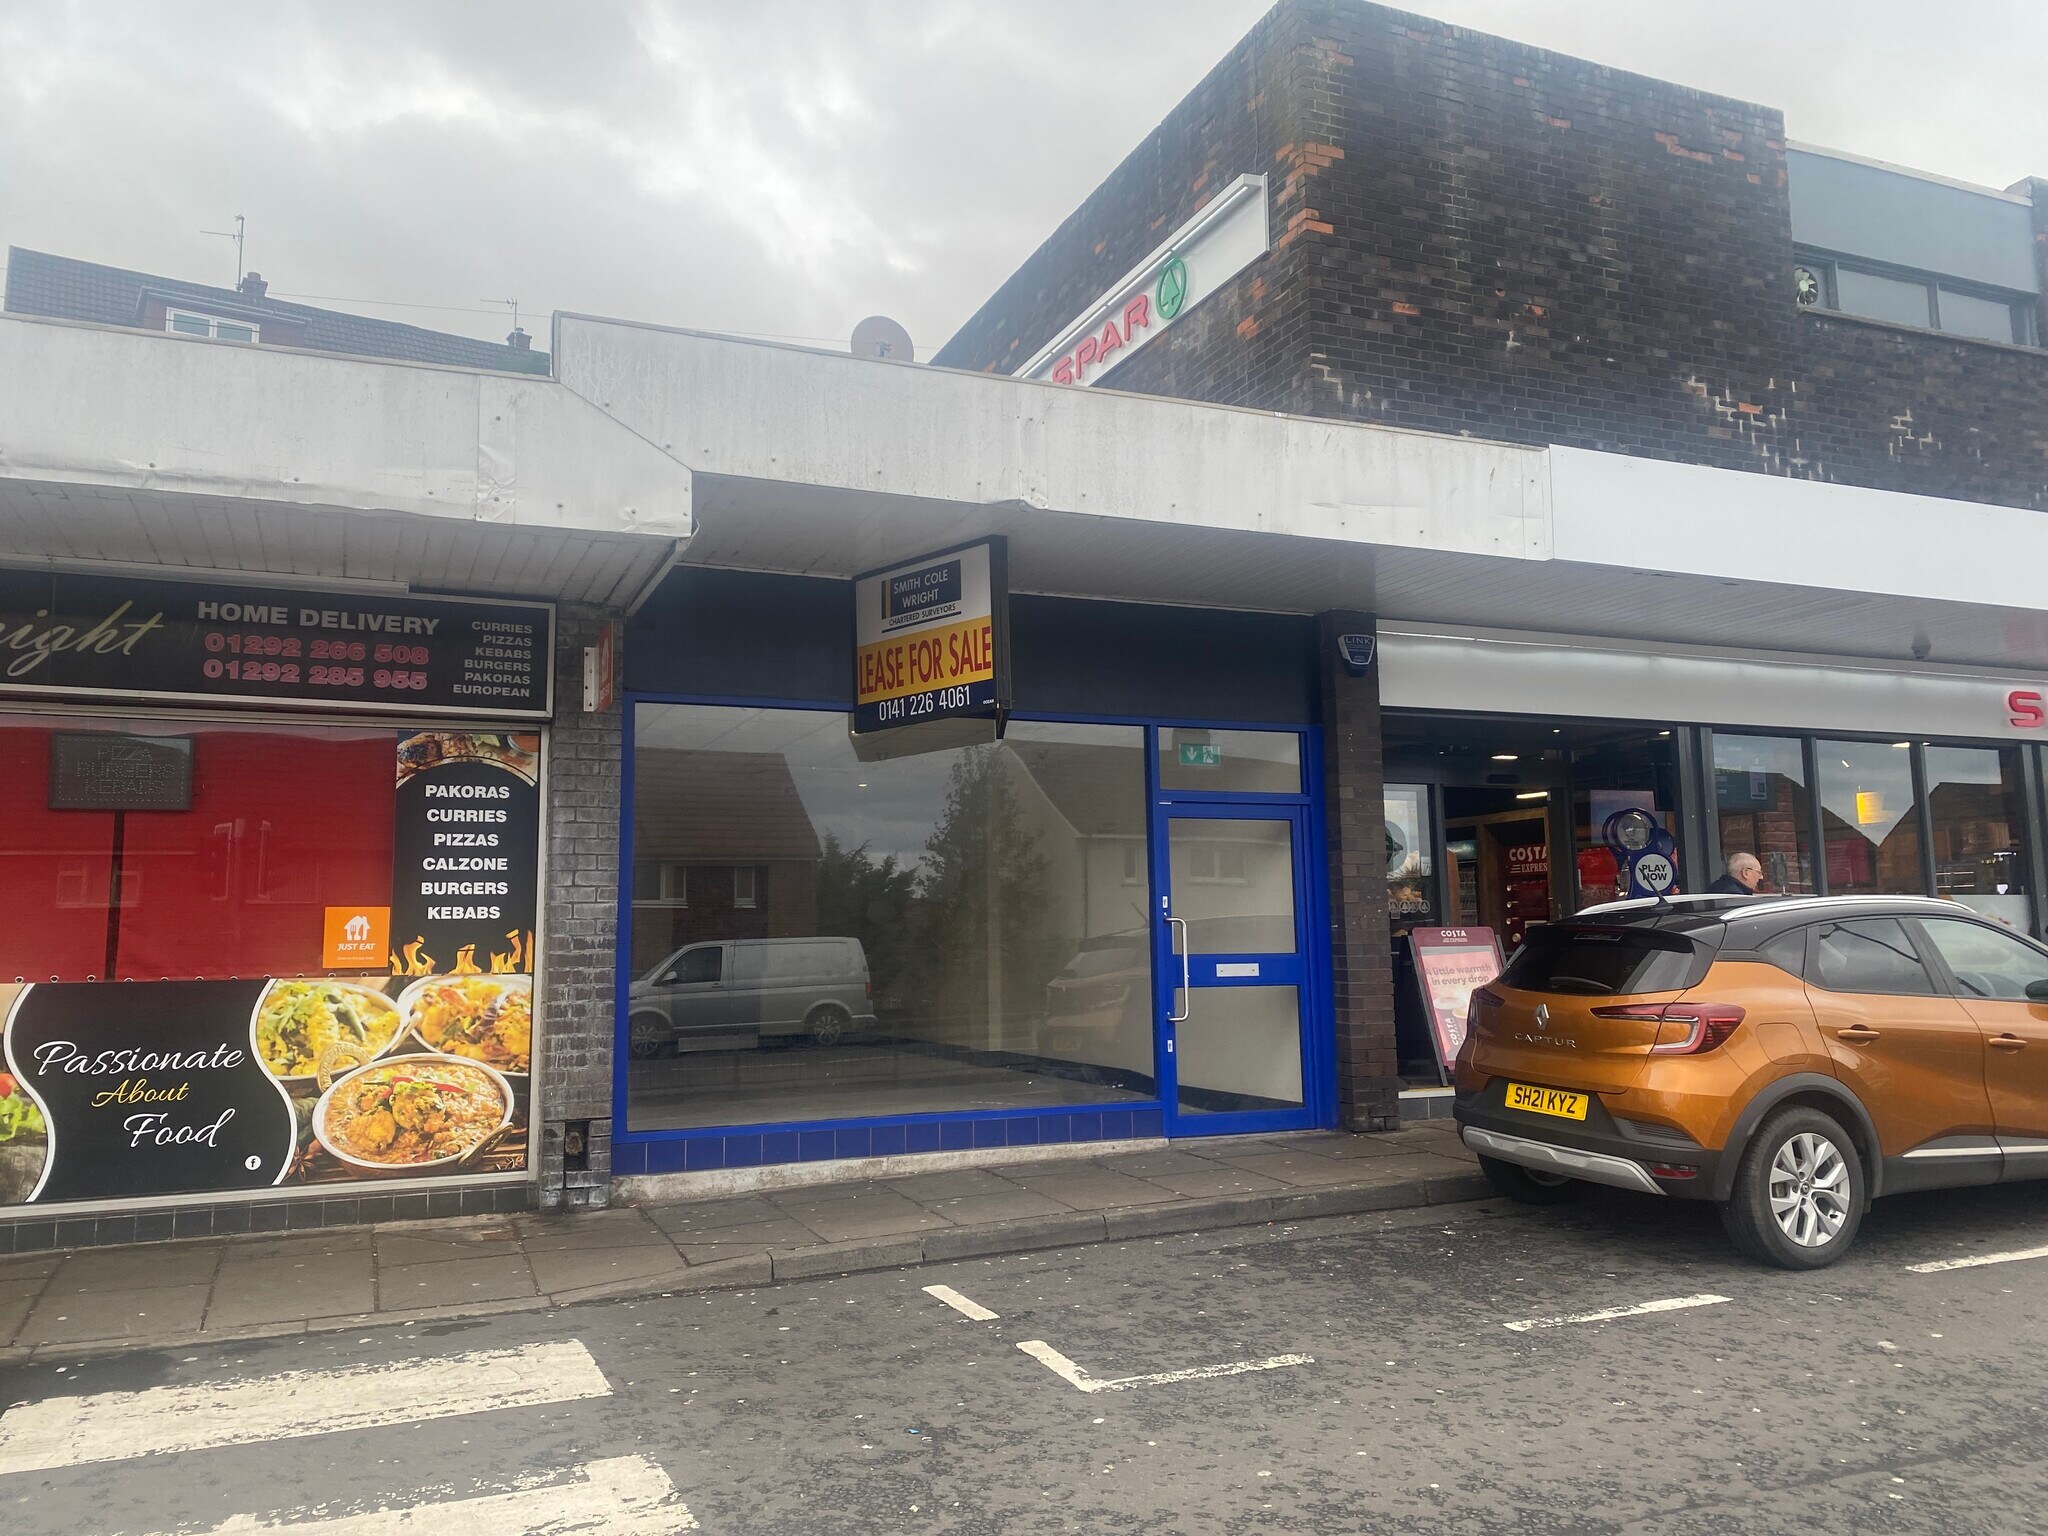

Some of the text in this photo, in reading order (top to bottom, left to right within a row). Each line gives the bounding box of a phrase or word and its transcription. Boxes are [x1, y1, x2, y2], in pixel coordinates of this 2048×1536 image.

[1053, 294, 1149, 385] SPAR
[894, 569, 949, 595] SMITH COLE
[902, 588, 940, 608] WRIGHT
[197, 601, 440, 635] HOME DELIVERY
[889, 603, 956, 627] CHARTERED SURVEYORS
[471, 621, 533, 634] CURRIES
[0, 600, 164, 677] ight
[483, 634, 533, 647] PIZZAS
[1345, 637, 1371, 645] LINK
[205, 632, 429, 665] 01292 266 508
[475, 647, 532, 660] KEBABS
[464, 659, 532, 672] BURGERS
[859, 625, 992, 695] LEASE FOR SALE
[203, 658, 428, 691] 01292 285 955
[464, 672, 531, 685] PAKORAS
[453, 684, 530, 698] EUROPEAN
[878, 685, 971, 721] 0141 226 4061
[2008, 691, 2044, 727] S
[425, 785, 510, 799] PAKORAS
[426, 809, 507, 823] CURRIES
[433, 833, 499, 846] PIZZAS
[422, 858, 508, 871] CALZONE
[1521, 863, 1548, 873] EXPRES
[1641, 864, 1667, 872] PLAY
[1642, 873, 1667, 881] NOW
[421, 882, 508, 895] BURGERS
[427, 906, 501, 920] KEBABS
[1441, 930, 1467, 938] COSTA
[337, 943, 376, 951] JUST EAT
[1432, 966, 1455, 976] little
[1457, 963, 1492, 974] warmth
[1432, 974, 1490, 986] in every drop
[1514, 1033, 1577, 1048] CAPTUR
[34, 1040, 245, 1076] Passionate
[91, 1078, 189, 1107] About
[1514, 1086, 1578, 1115] SH21 KYZ
[123, 1108, 236, 1148] Food
